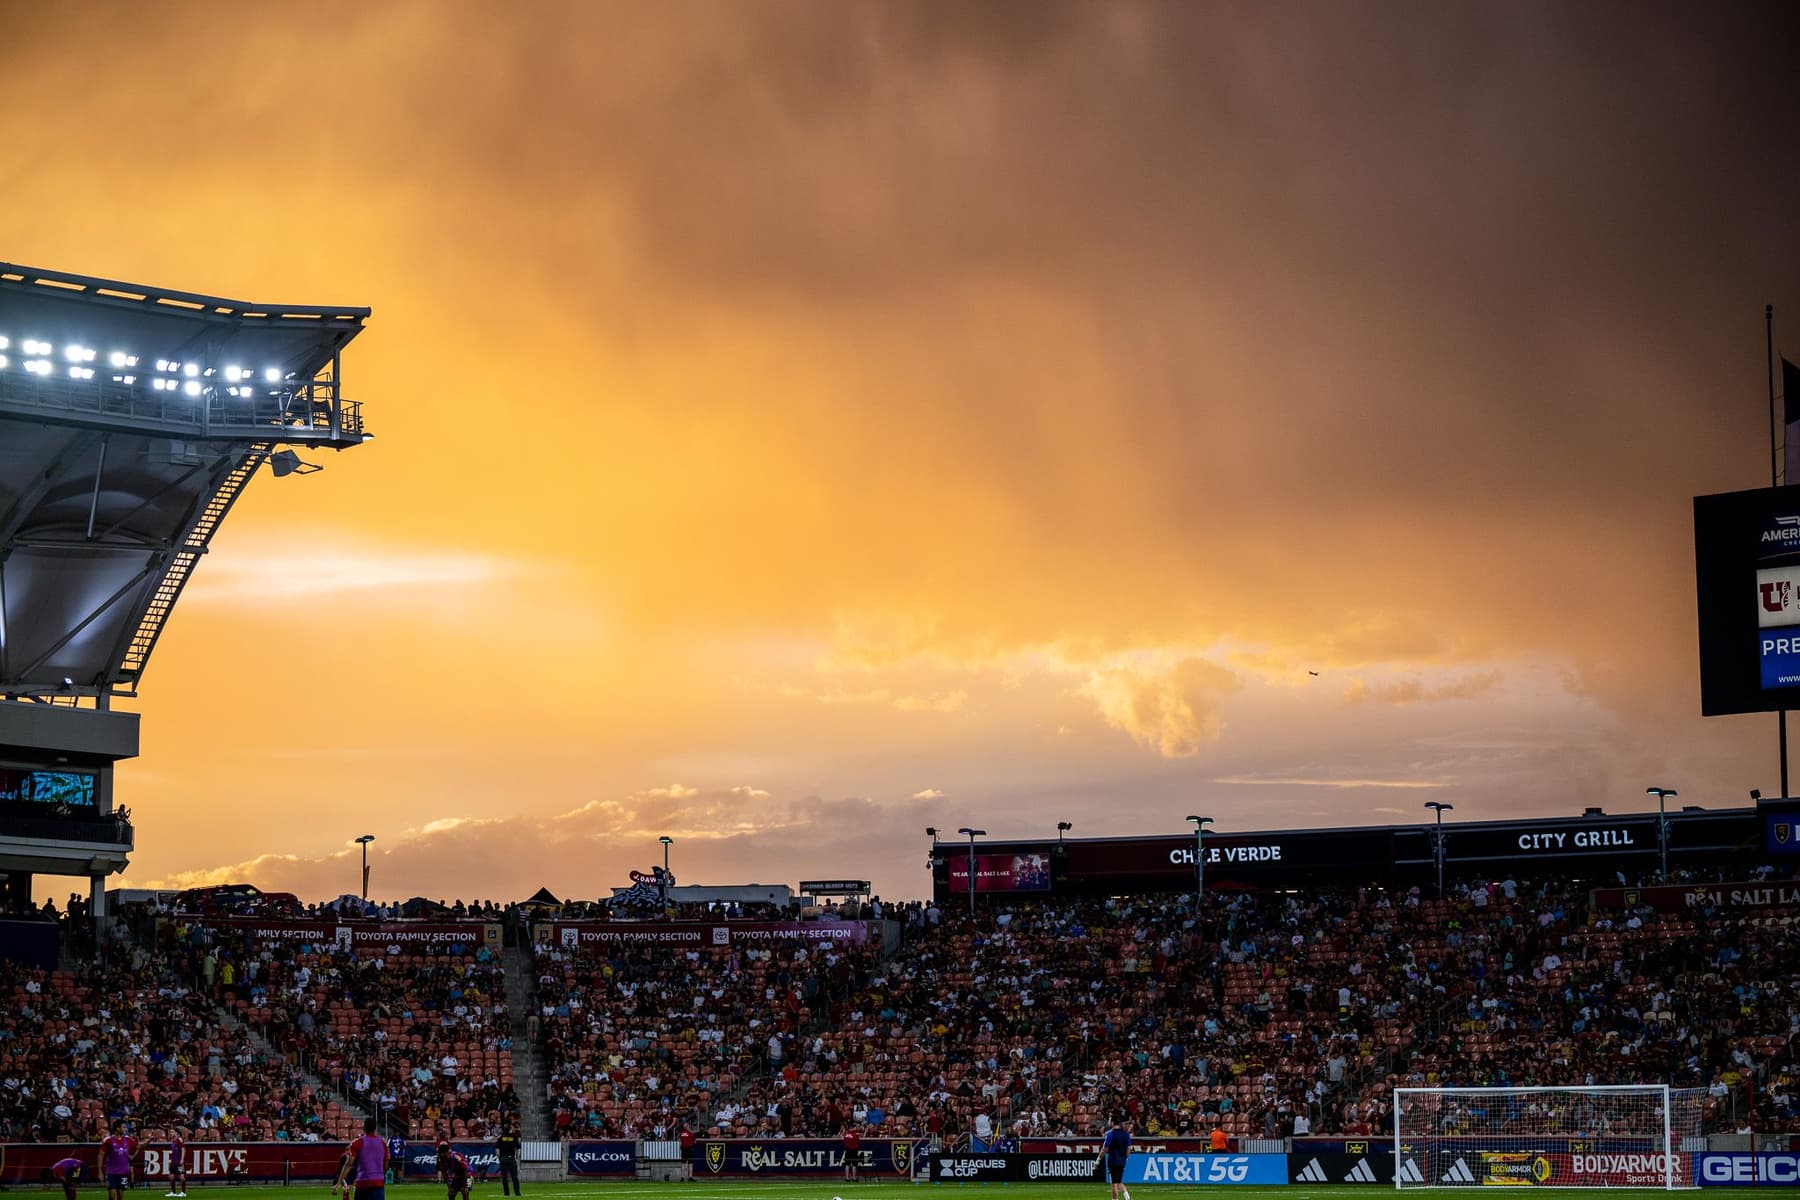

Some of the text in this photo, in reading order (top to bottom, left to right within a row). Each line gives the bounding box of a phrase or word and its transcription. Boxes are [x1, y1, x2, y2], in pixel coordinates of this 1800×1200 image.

[1518, 829, 1634, 849] CITY GRILL
[1169, 845, 1282, 864] CHE VERDE
[1730, 888, 1774, 906] SALT
[354, 931, 394, 941] TOYOTA
[433, 931, 476, 941] SECTION
[582, 932, 621, 941] TOYOTA
[659, 932, 701, 941] SECTION
[809, 929, 851, 938] SECTION
[575, 1152, 630, 1163] RSL.COM
[784, 1150, 825, 1168] SALT
[954, 1159, 1006, 1169] LEAGUES
[1572, 1154, 1683, 1174] BODYARMOR
[954, 1169, 979, 1177] CUP
[1028, 1159, 1096, 1179] @LEAGUESCUP
[1143, 1157, 1249, 1182] AT&T 5G
[1491, 1164, 1532, 1173] BODYARMOR
[1703, 1156, 1800, 1182] GEIC
[1626, 1174, 1656, 1183] Sports
